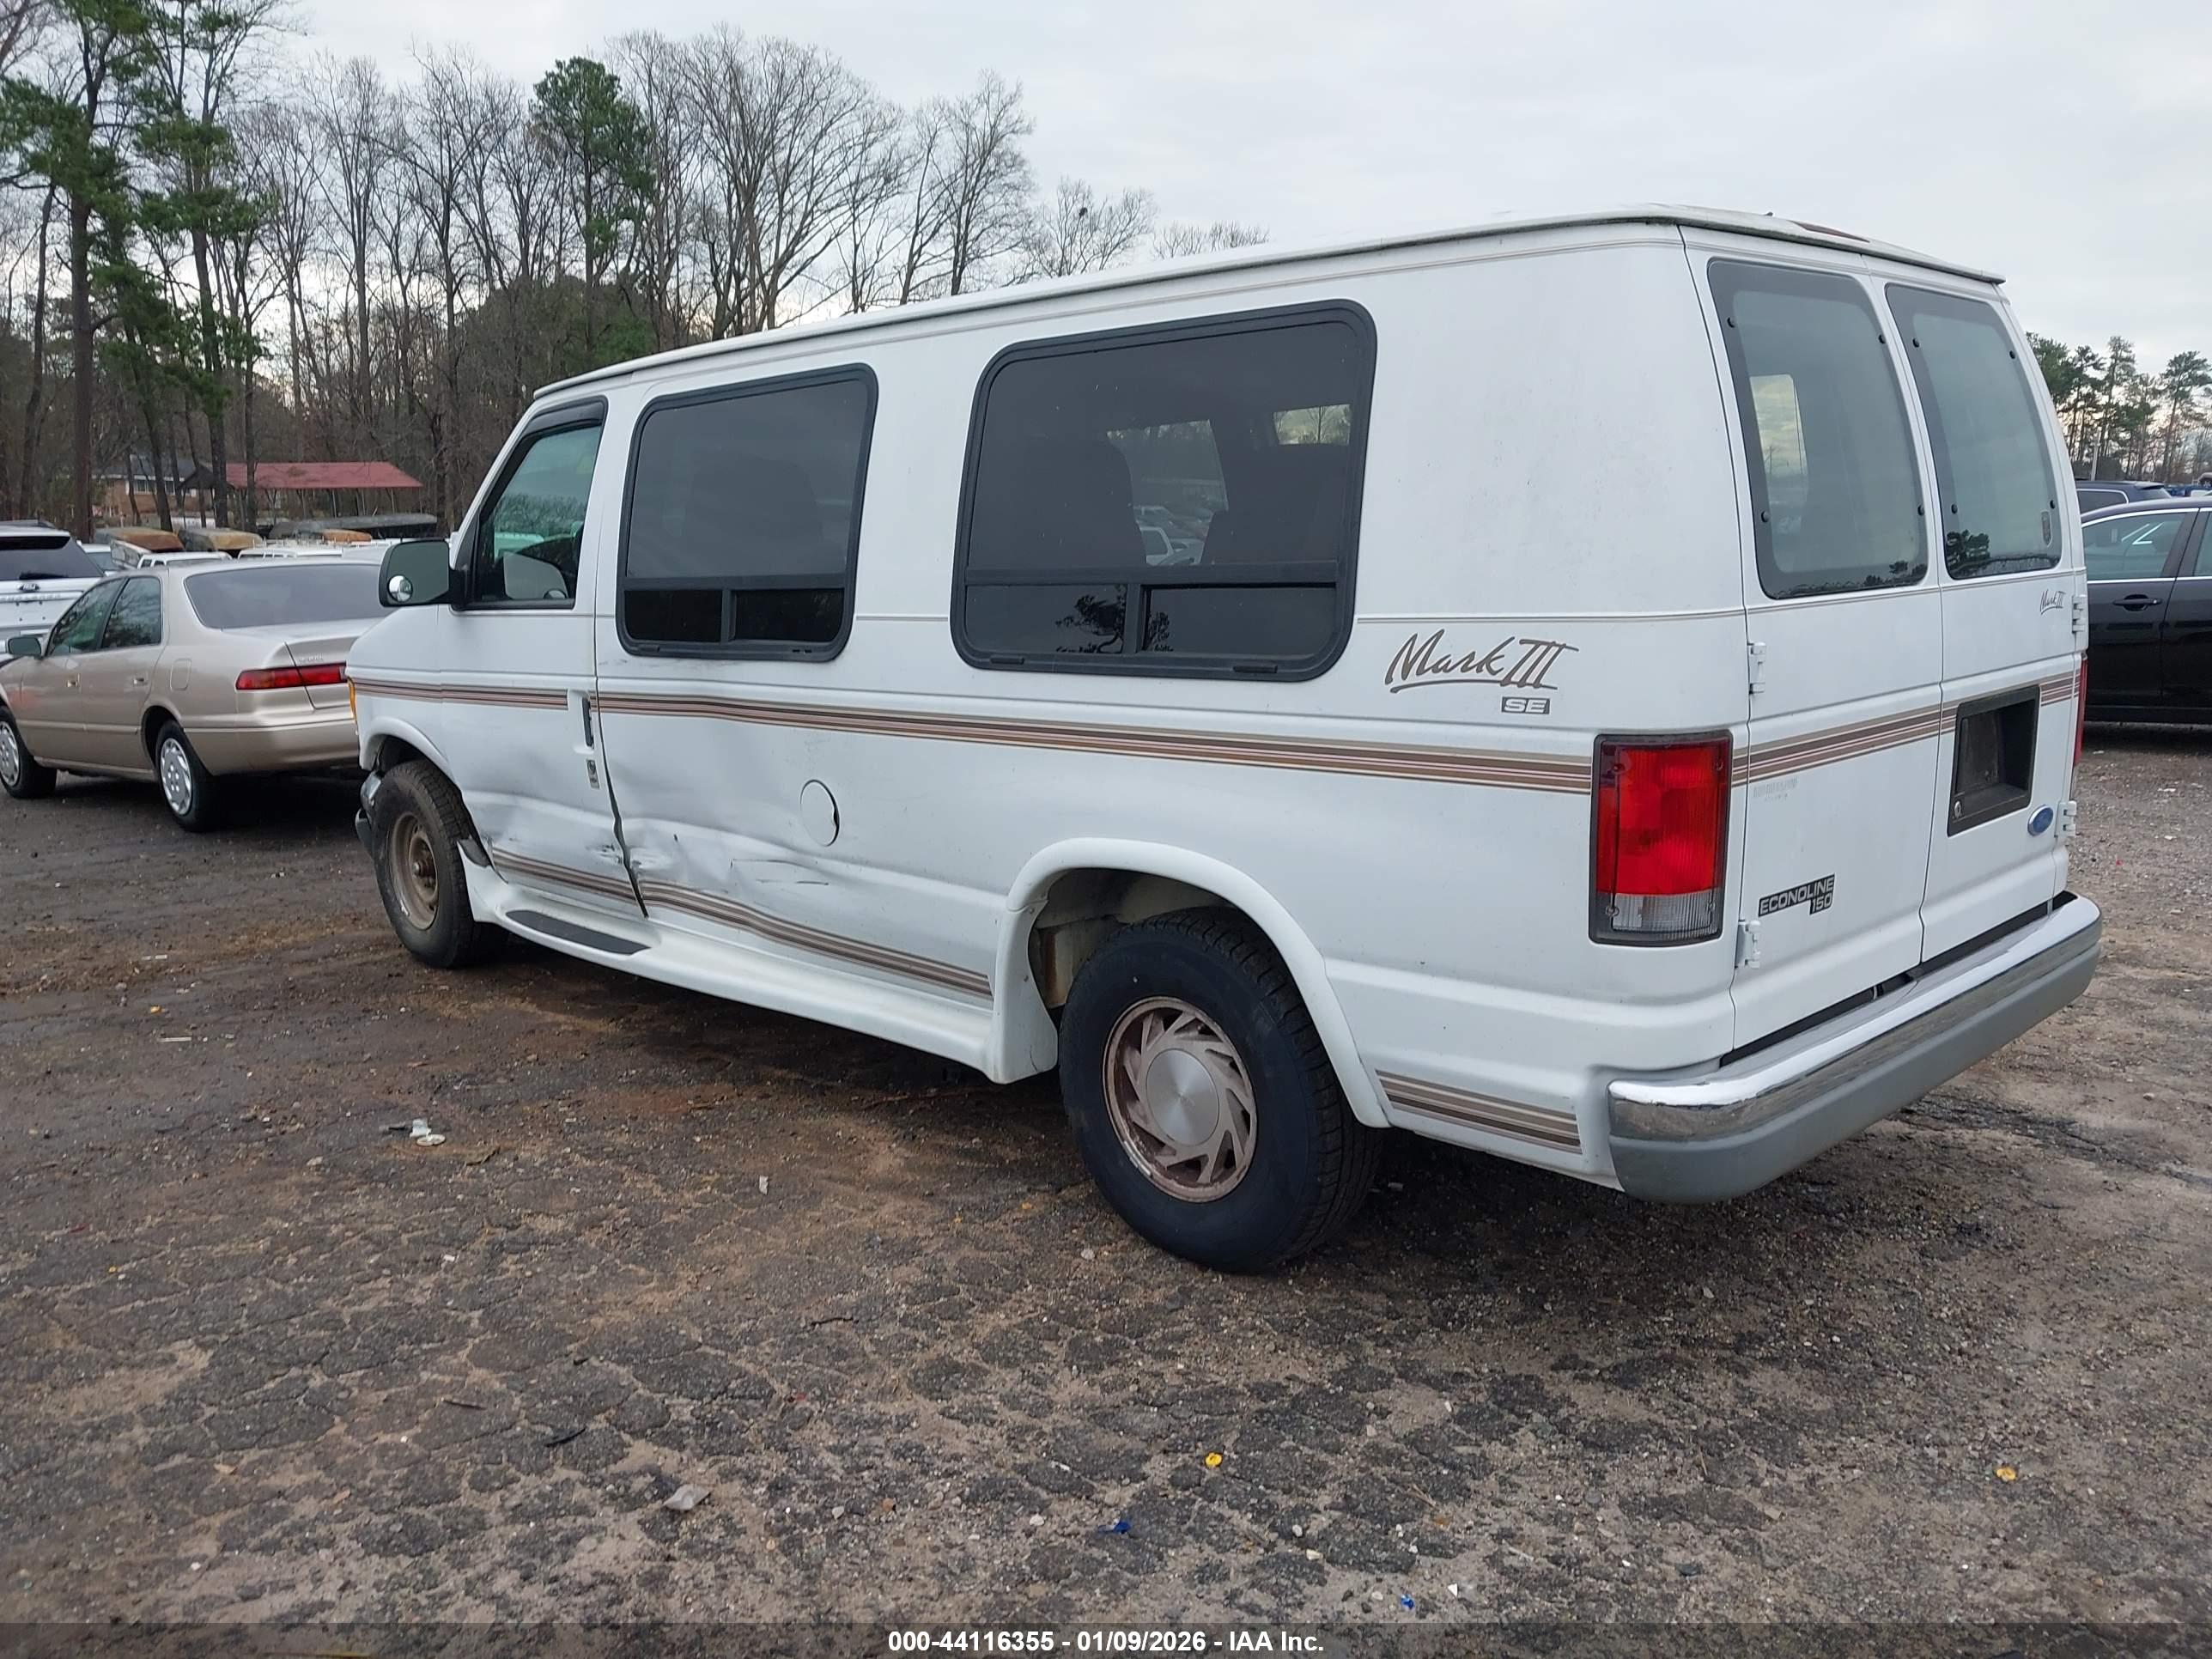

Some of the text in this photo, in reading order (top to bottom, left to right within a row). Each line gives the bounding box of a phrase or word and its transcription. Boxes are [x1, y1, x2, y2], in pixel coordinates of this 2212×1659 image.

[1384, 629, 1579, 689] Mark III
[1503, 697, 1549, 714] SE
[1759, 876, 1835, 915] ECONOLINE
[1811, 892, 1832, 914] 150
